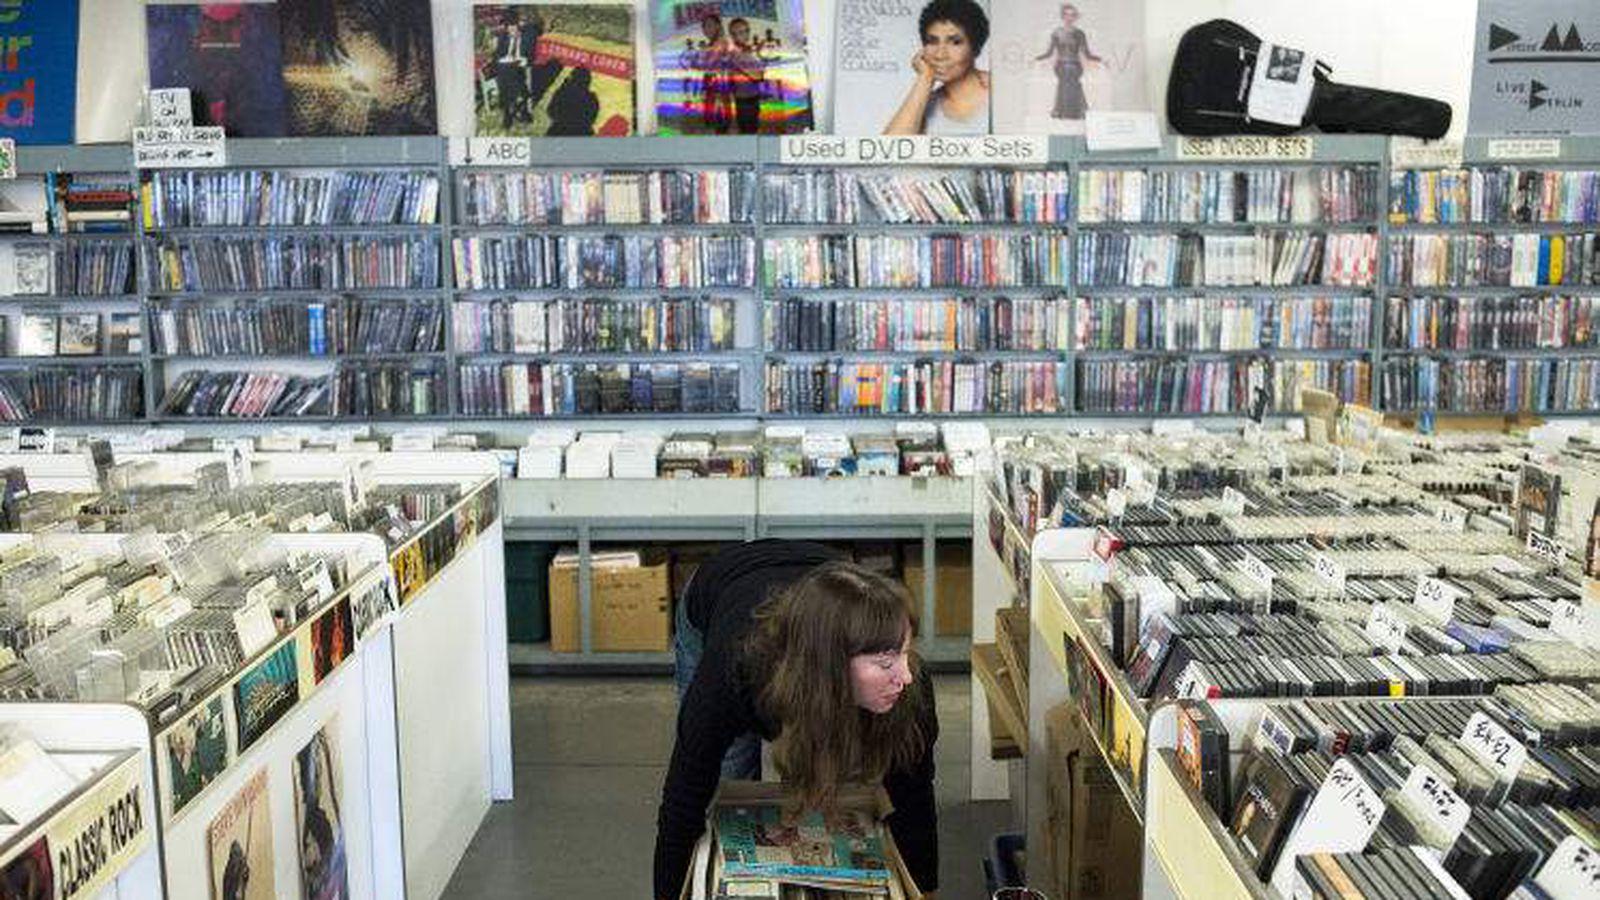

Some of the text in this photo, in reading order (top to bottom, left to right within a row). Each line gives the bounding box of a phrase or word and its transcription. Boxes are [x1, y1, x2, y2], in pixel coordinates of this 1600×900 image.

[486, 140, 528, 158] ABC
[788, 138, 1033, 160] Used DVD Box Sets
[1183, 137, 1214, 156] USED
[1277, 137, 1307, 156] SETS
[59, 817, 107, 898] CLASSIC
[109, 787, 144, 853] ROCK
